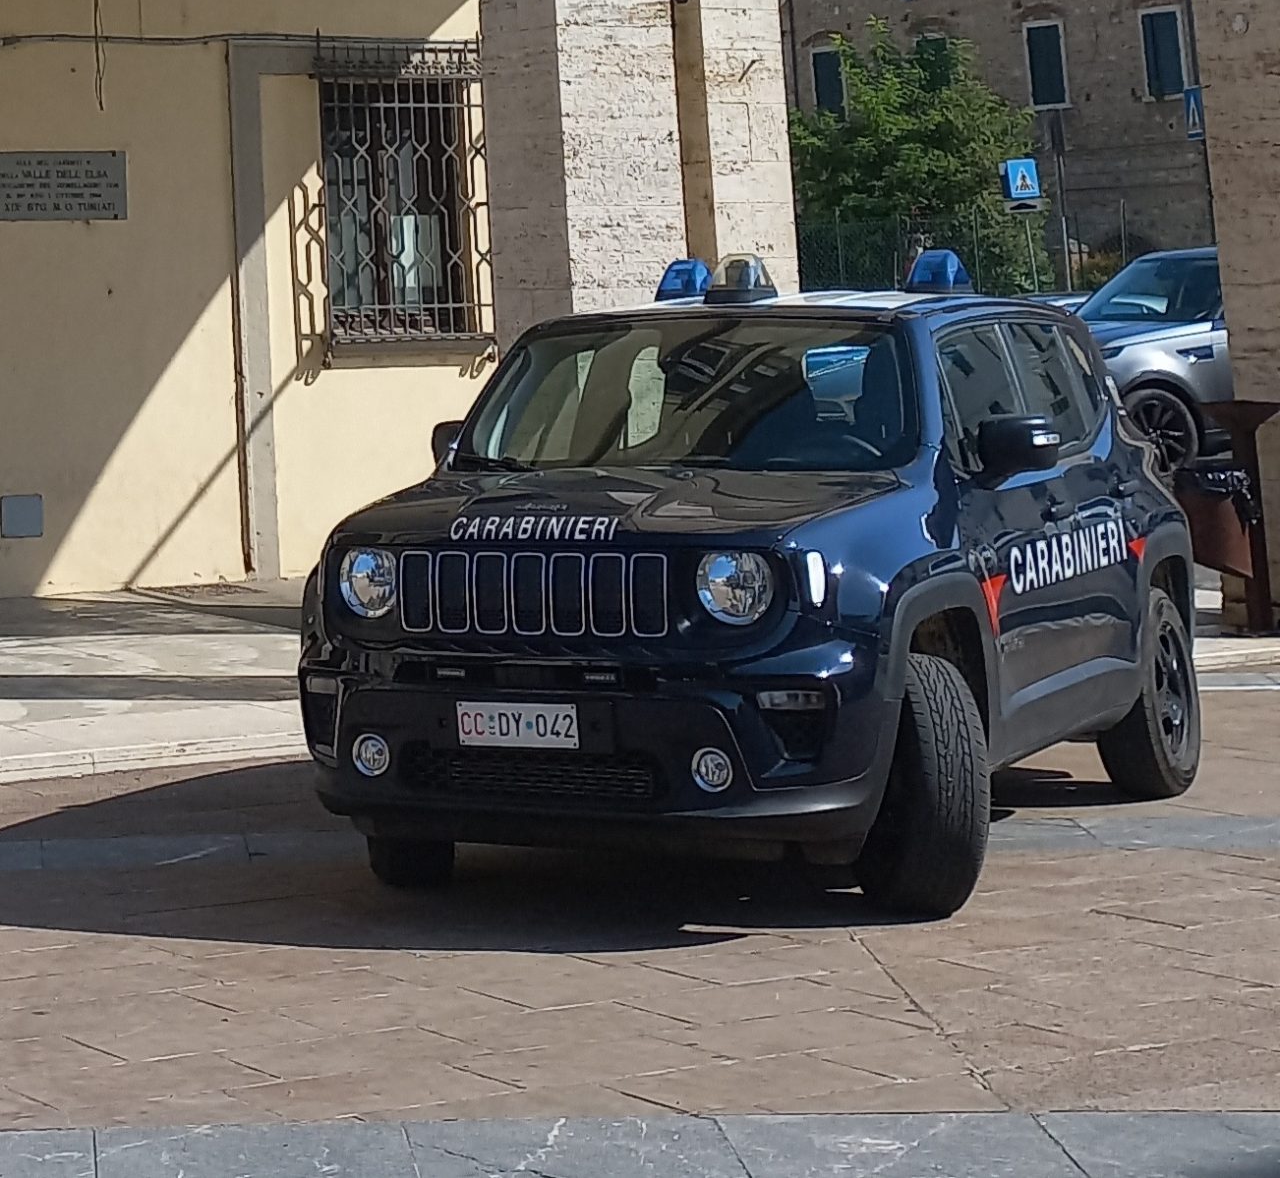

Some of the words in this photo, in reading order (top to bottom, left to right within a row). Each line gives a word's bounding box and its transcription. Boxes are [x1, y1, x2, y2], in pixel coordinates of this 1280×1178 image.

[21, 169, 51, 179] VALLE
[450, 515, 619, 541] CARABINIERI
[1009, 518, 1128, 595] CARABINIERI
